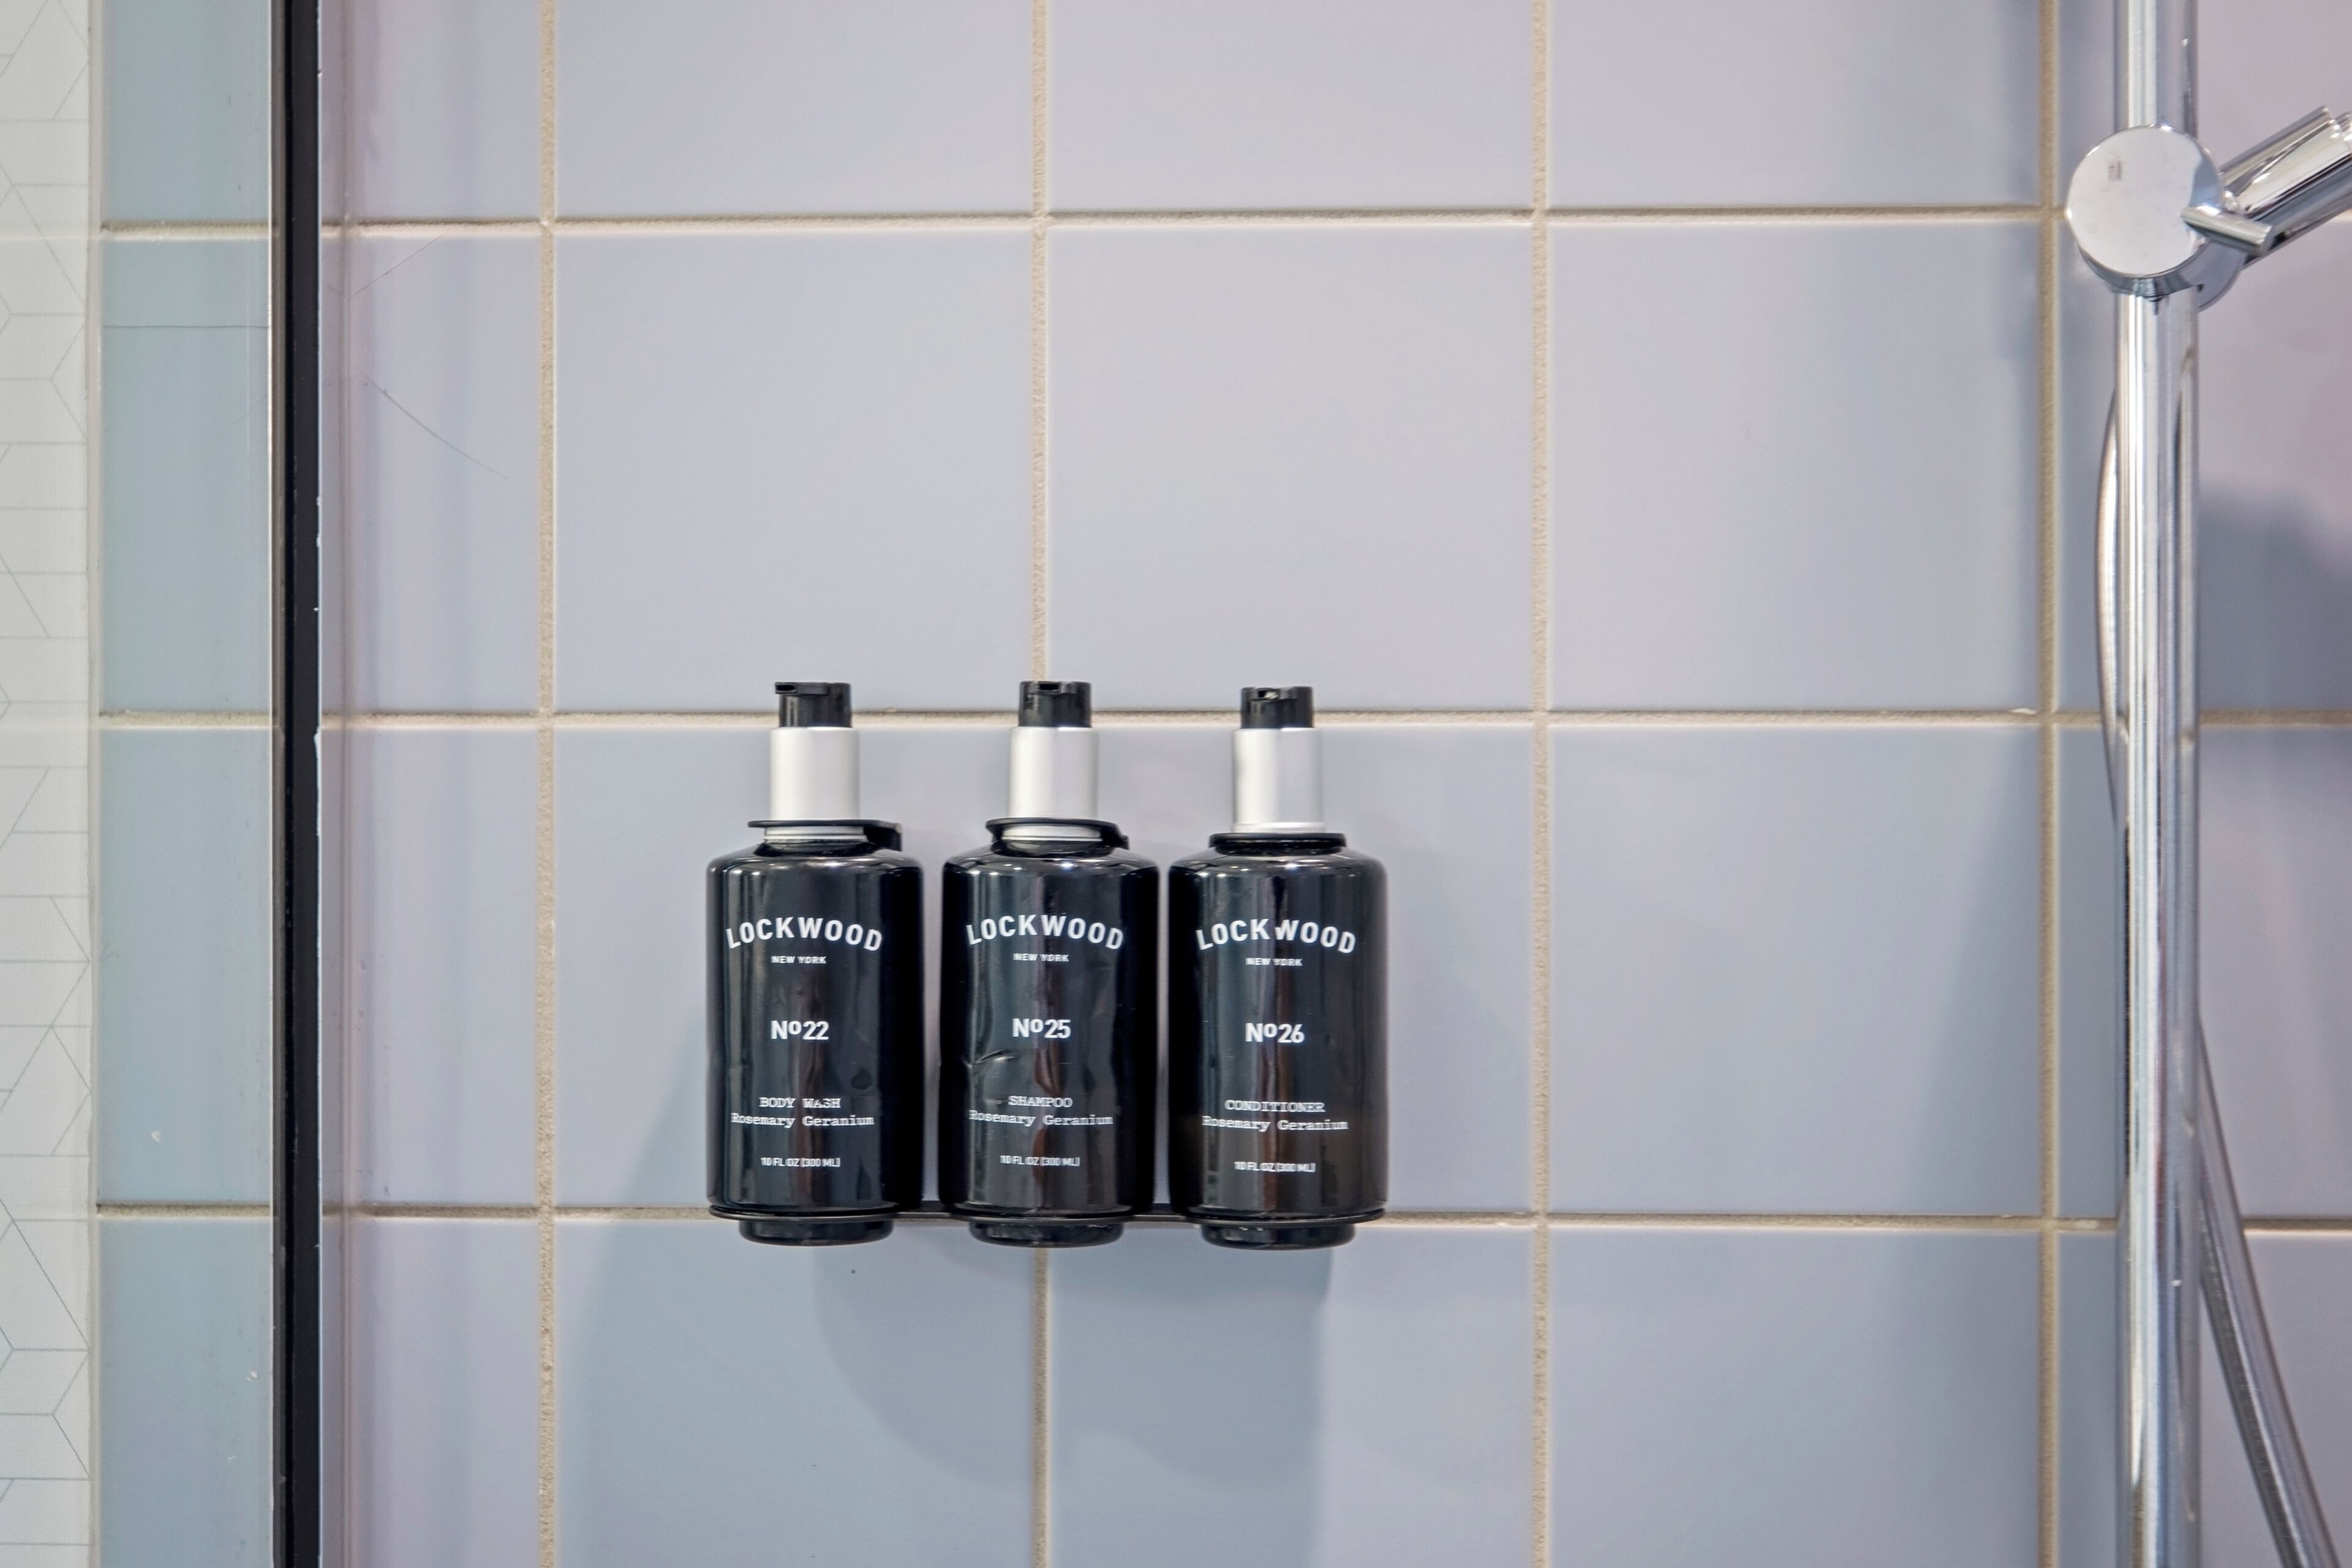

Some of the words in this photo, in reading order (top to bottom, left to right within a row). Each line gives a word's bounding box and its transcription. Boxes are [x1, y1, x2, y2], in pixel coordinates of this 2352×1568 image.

[726, 917, 882, 951] LOCKWOOD
[966, 914, 1124, 949] LOCKWOOD
[1196, 919, 1356, 953] LOCKWOOD
[759, 1097, 796, 1108] BODY
[802, 1098, 841, 1108] WASH
[1008, 1096, 1072, 1107] SHAMPOO
[1224, 1100, 1326, 1112] CONDITIONER
[731, 1113, 796, 1128] Rosemary
[802, 1115, 875, 1126] Geranium
[968, 1110, 1036, 1126] Rosemary
[1042, 1114, 1114, 1125] Geranium
[1202, 1115, 1271, 1132] Rosemary
[1276, 1119, 1349, 1130] Geranium
[760, 1157, 772, 1166] 10
[772, 1158, 785, 1166] FL
[785, 1158, 800, 1167] OZ
